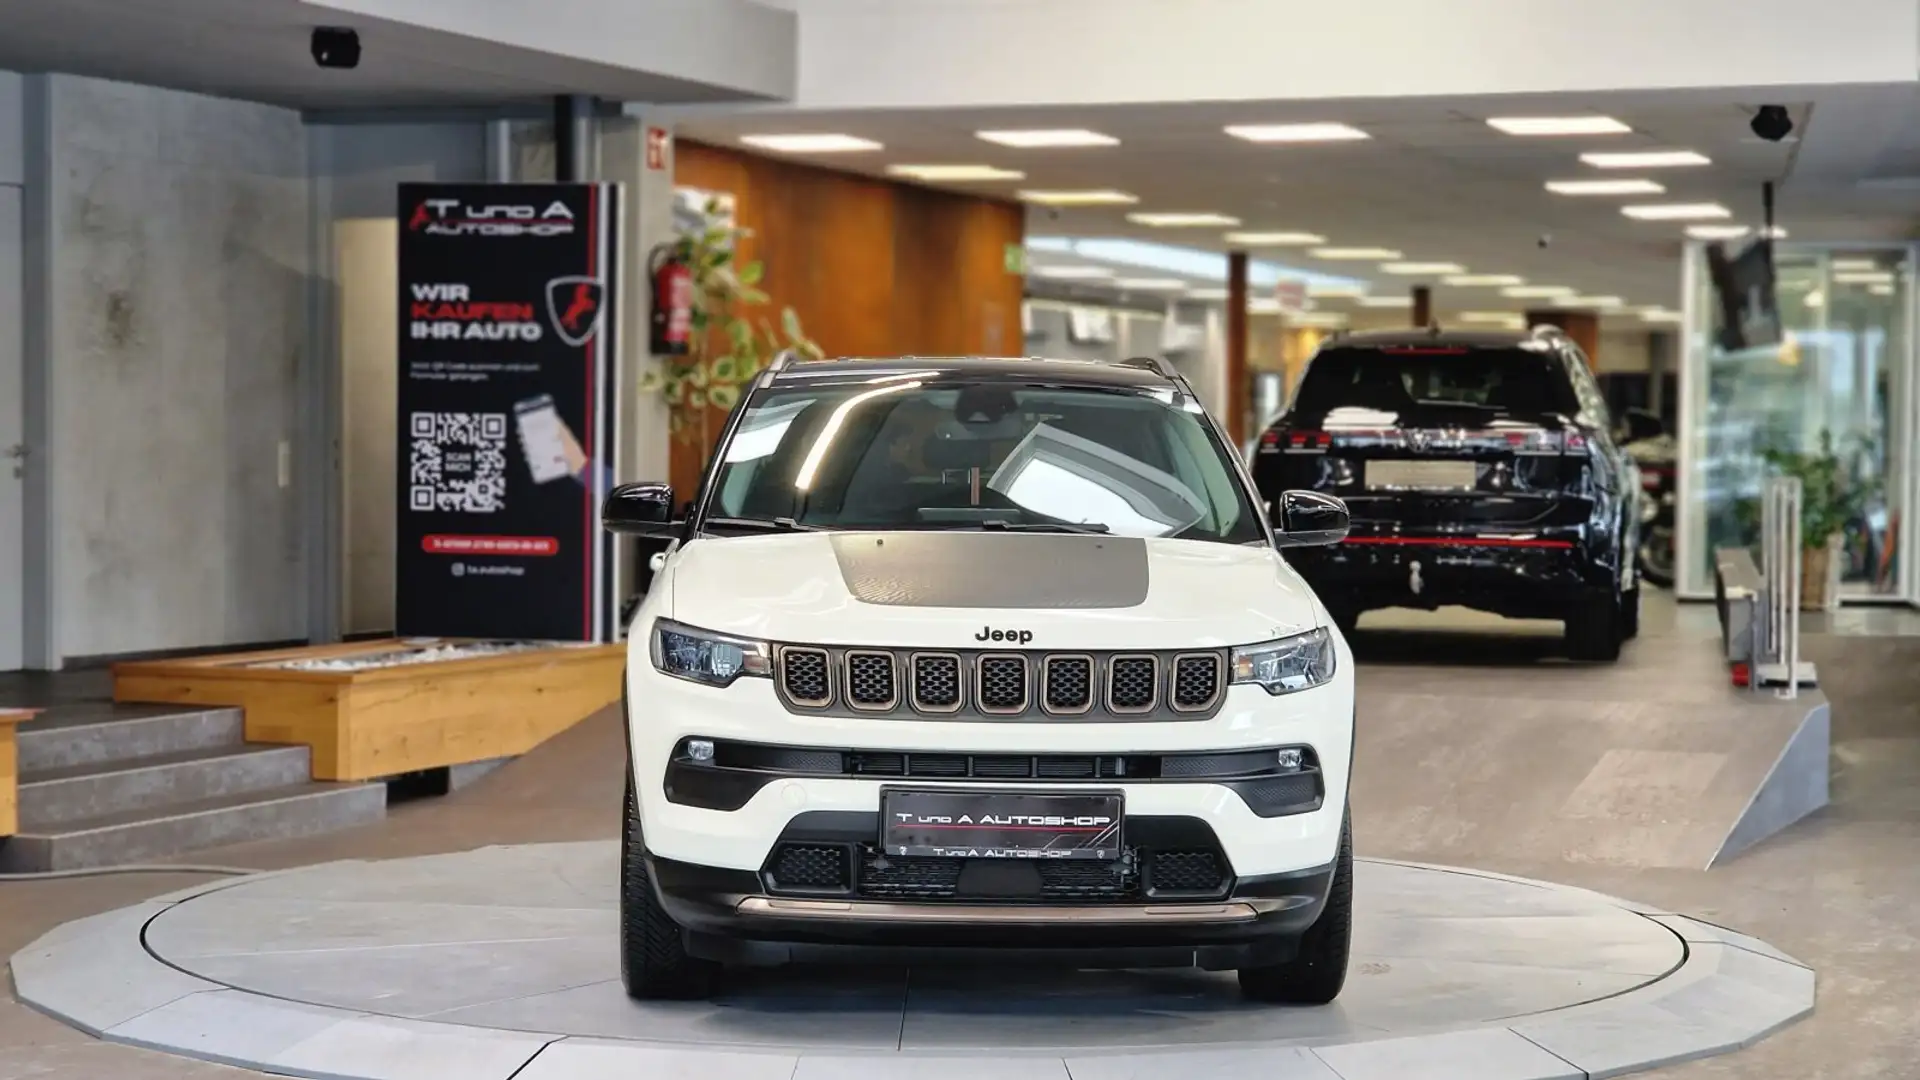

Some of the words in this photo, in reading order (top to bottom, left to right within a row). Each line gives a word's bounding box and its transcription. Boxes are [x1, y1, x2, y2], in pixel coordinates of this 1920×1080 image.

[424, 198, 460, 218] T
[541, 200, 575, 219] A
[424, 222, 575, 236] AUTOSHOP
[410, 282, 470, 301] WIR
[410, 302, 535, 321] KAUFEN
[409, 321, 461, 340] IHR
[463, 321, 543, 341] AUTO
[974, 625, 1034, 646] Jeep
[896, 813, 914, 823] T
[918, 815, 953, 824] und
[957, 814, 977, 825] A
[980, 814, 1112, 827] AUTOSHOP
[933, 848, 945, 857] T
[967, 849, 980, 858] A
[984, 848, 1073, 858] AUTOSHOP
